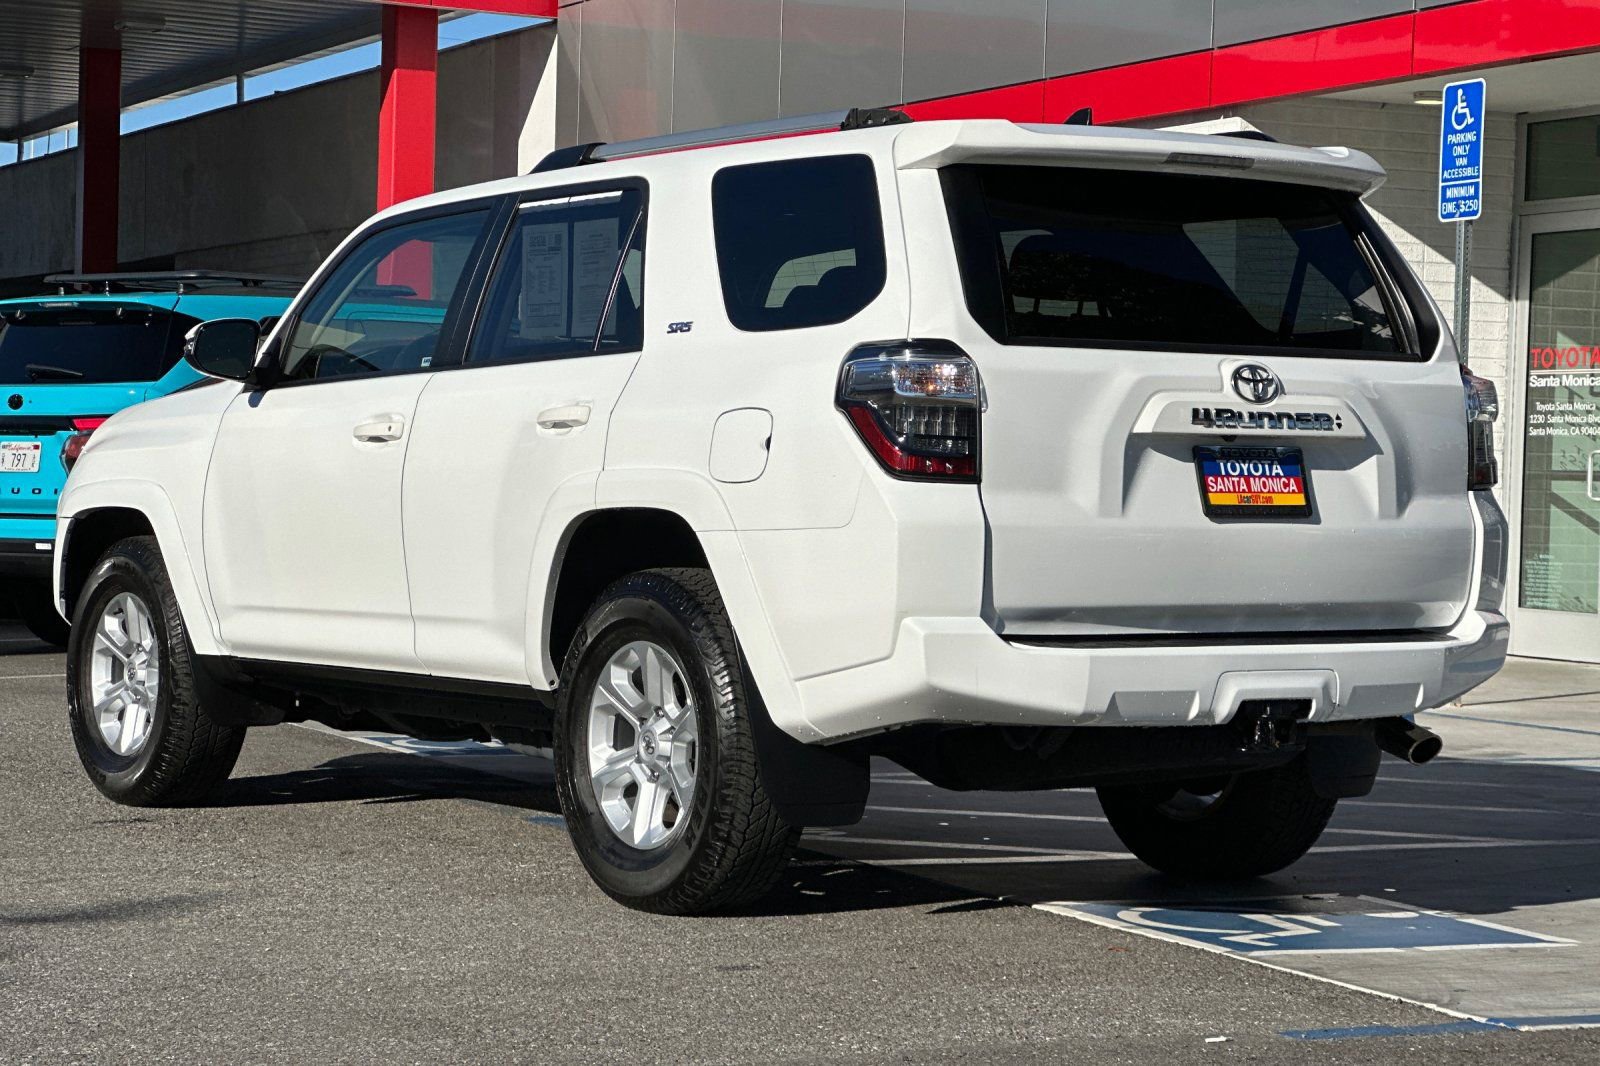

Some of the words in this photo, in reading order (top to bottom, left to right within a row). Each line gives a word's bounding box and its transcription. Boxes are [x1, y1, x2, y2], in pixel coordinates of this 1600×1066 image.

[1447, 131, 1477, 144] PARKING
[1452, 144, 1470, 156] ONLY
[1455, 156, 1468, 166] VAN
[1443, 166, 1479, 179] ACCESSIBLE
[1446, 185, 1475, 199] MINIMUM
[1458, 199, 1478, 213] $250
[1531, 346, 1600, 368] TOYOTA
[1530, 375, 1560, 387] Santa
[1562, 374, 1600, 387] Monica
[1536, 402, 1555, 412] Toyota
[1556, 402, 1573, 411] Santa
[1574, 401, 1596, 411] Monica
[1547, 414, 1564, 424] Santa
[1565, 413, 1587, 423] Monica
[1529, 426, 1545, 436] Santa
[1570, 426, 1580, 436] CA
[11, 453, 27, 468] 797
[1216, 459, 1284, 476] TOYOTA
[1208, 476, 1248, 493] SANTA
[1250, 476, 1298, 493] MONICA
